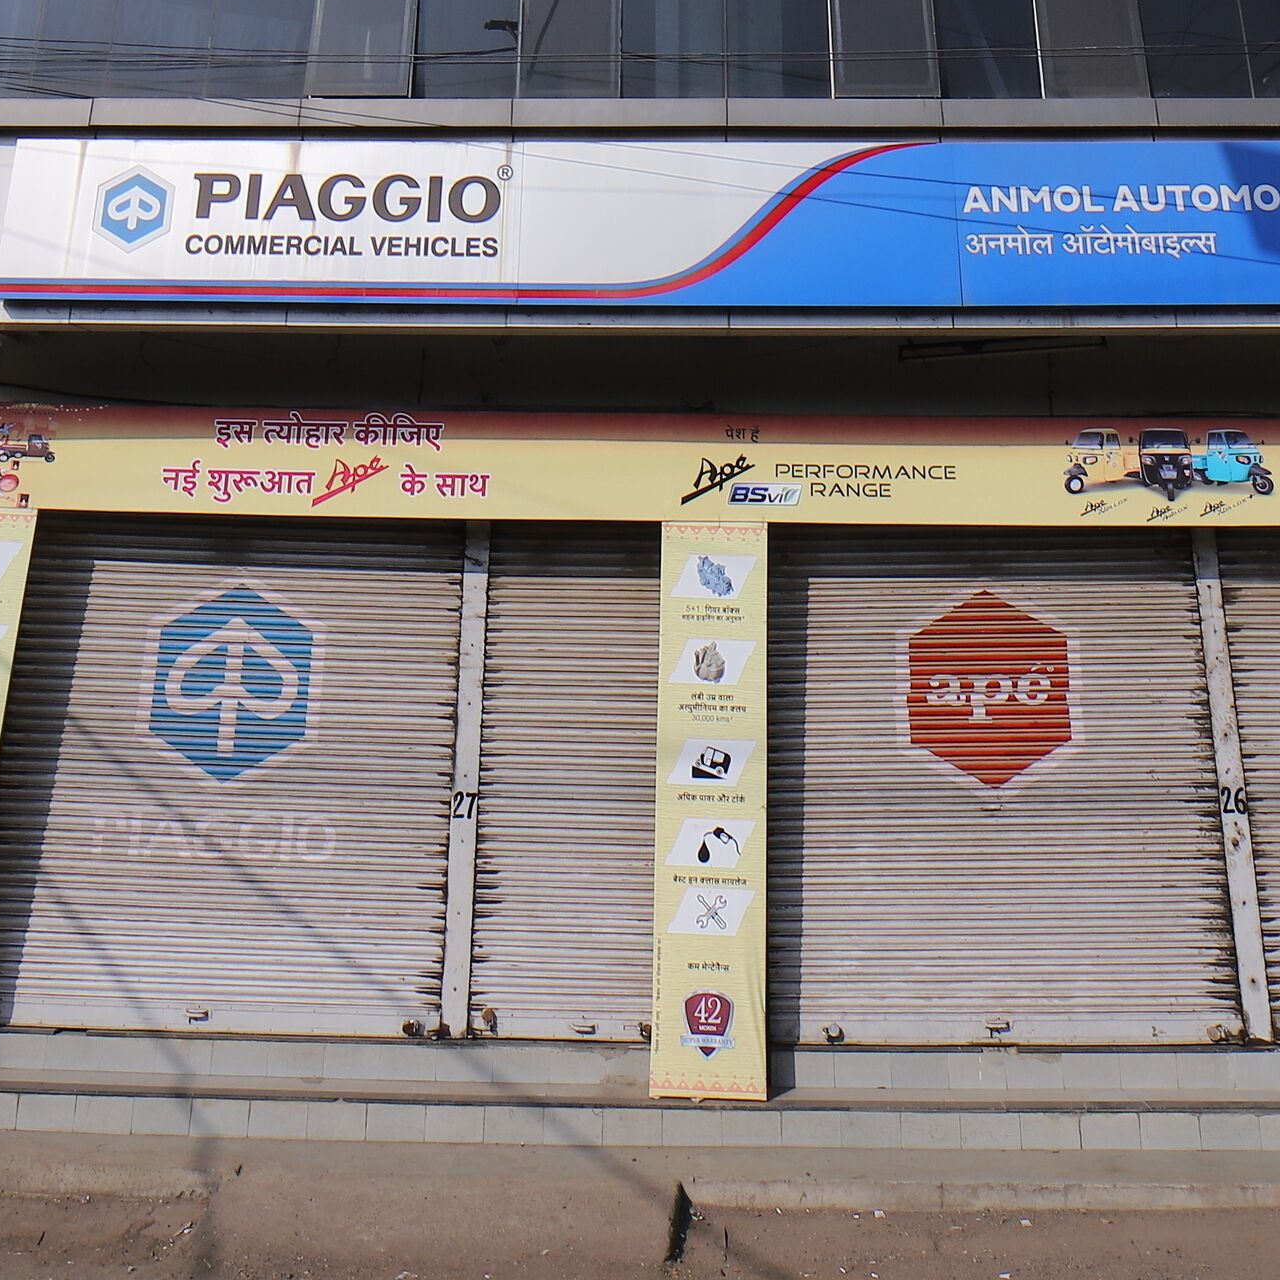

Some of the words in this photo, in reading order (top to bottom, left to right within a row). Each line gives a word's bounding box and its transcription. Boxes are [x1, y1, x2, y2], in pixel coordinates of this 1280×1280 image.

[194, 173, 502, 222] PIAGGIO
[962, 185, 1105, 213] ANMOL
[185, 234, 362, 256] COMMERCIAL
[371, 235, 499, 257] VEHICLES
[964, 225, 1053, 255] अनमोल
[1062, 224, 1217, 258] ऑटोमोबाइल्स
[216, 419, 257, 448] इस
[263, 411, 347, 448] त्योहार
[354, 414, 443, 451] कीजिए
[725, 425, 746, 439] पेश
[162, 460, 201, 496] नई
[400, 464, 427, 497] के
[435, 473, 490, 497] साथ
[775, 463, 956, 480] PERFORMANCE
[810, 483, 891, 498] RANGE
[451, 792, 478, 819] 27
[1221, 787, 1247, 814] 26
[694, 997, 722, 1024] 42
